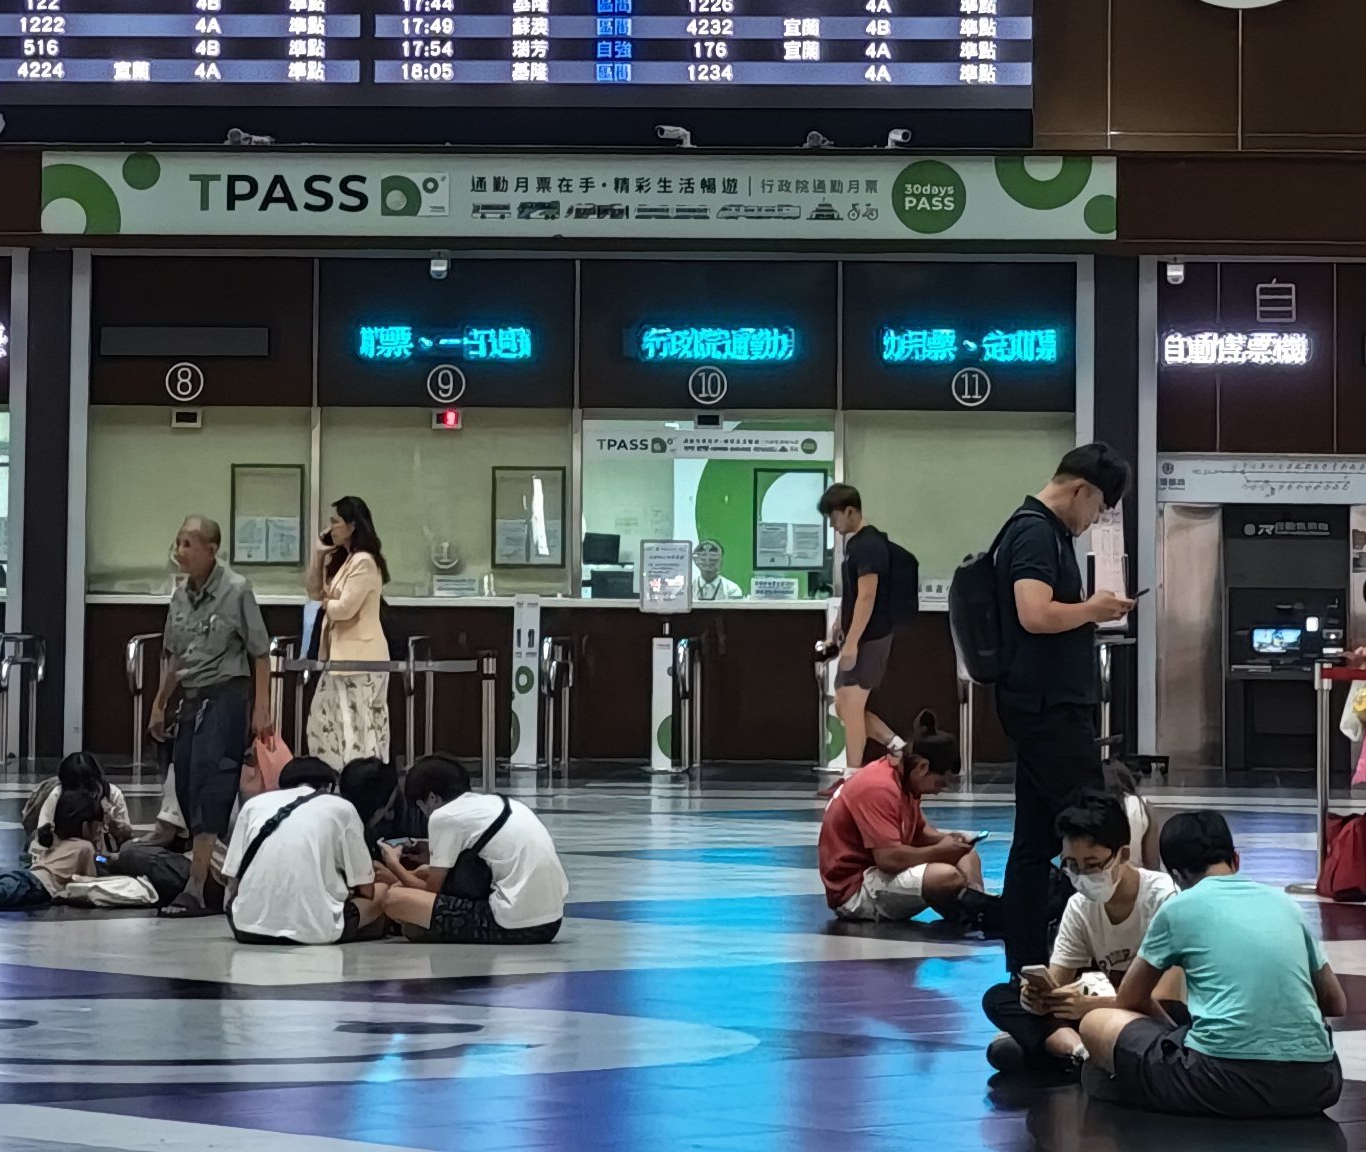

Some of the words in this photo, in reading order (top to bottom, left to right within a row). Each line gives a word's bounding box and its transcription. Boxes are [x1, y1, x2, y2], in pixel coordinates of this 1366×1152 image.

[20, 15, 66, 33] 1222
[194, 17, 222, 34] 4A
[402, 17, 454, 35] 17:49
[686, 18, 734, 36] 4232
[865, 19, 891, 36] 4B
[23, 39, 58, 56] 516
[195, 39, 220, 56] 4B
[402, 40, 453, 57] 17:54
[694, 41, 727, 58] 176
[865, 42, 891, 59] 4A
[17, 61, 65, 79] 4224
[194, 62, 222, 80] 4A
[401, 62, 454, 81] 18:05
[687, 64, 734, 81] 1234
[864, 64, 892, 82] 4A
[188, 173, 369, 213] TPASS
[904, 183, 954, 197] 30days
[904, 197, 955, 211] PASS
[596, 438, 648, 451] TPASS
